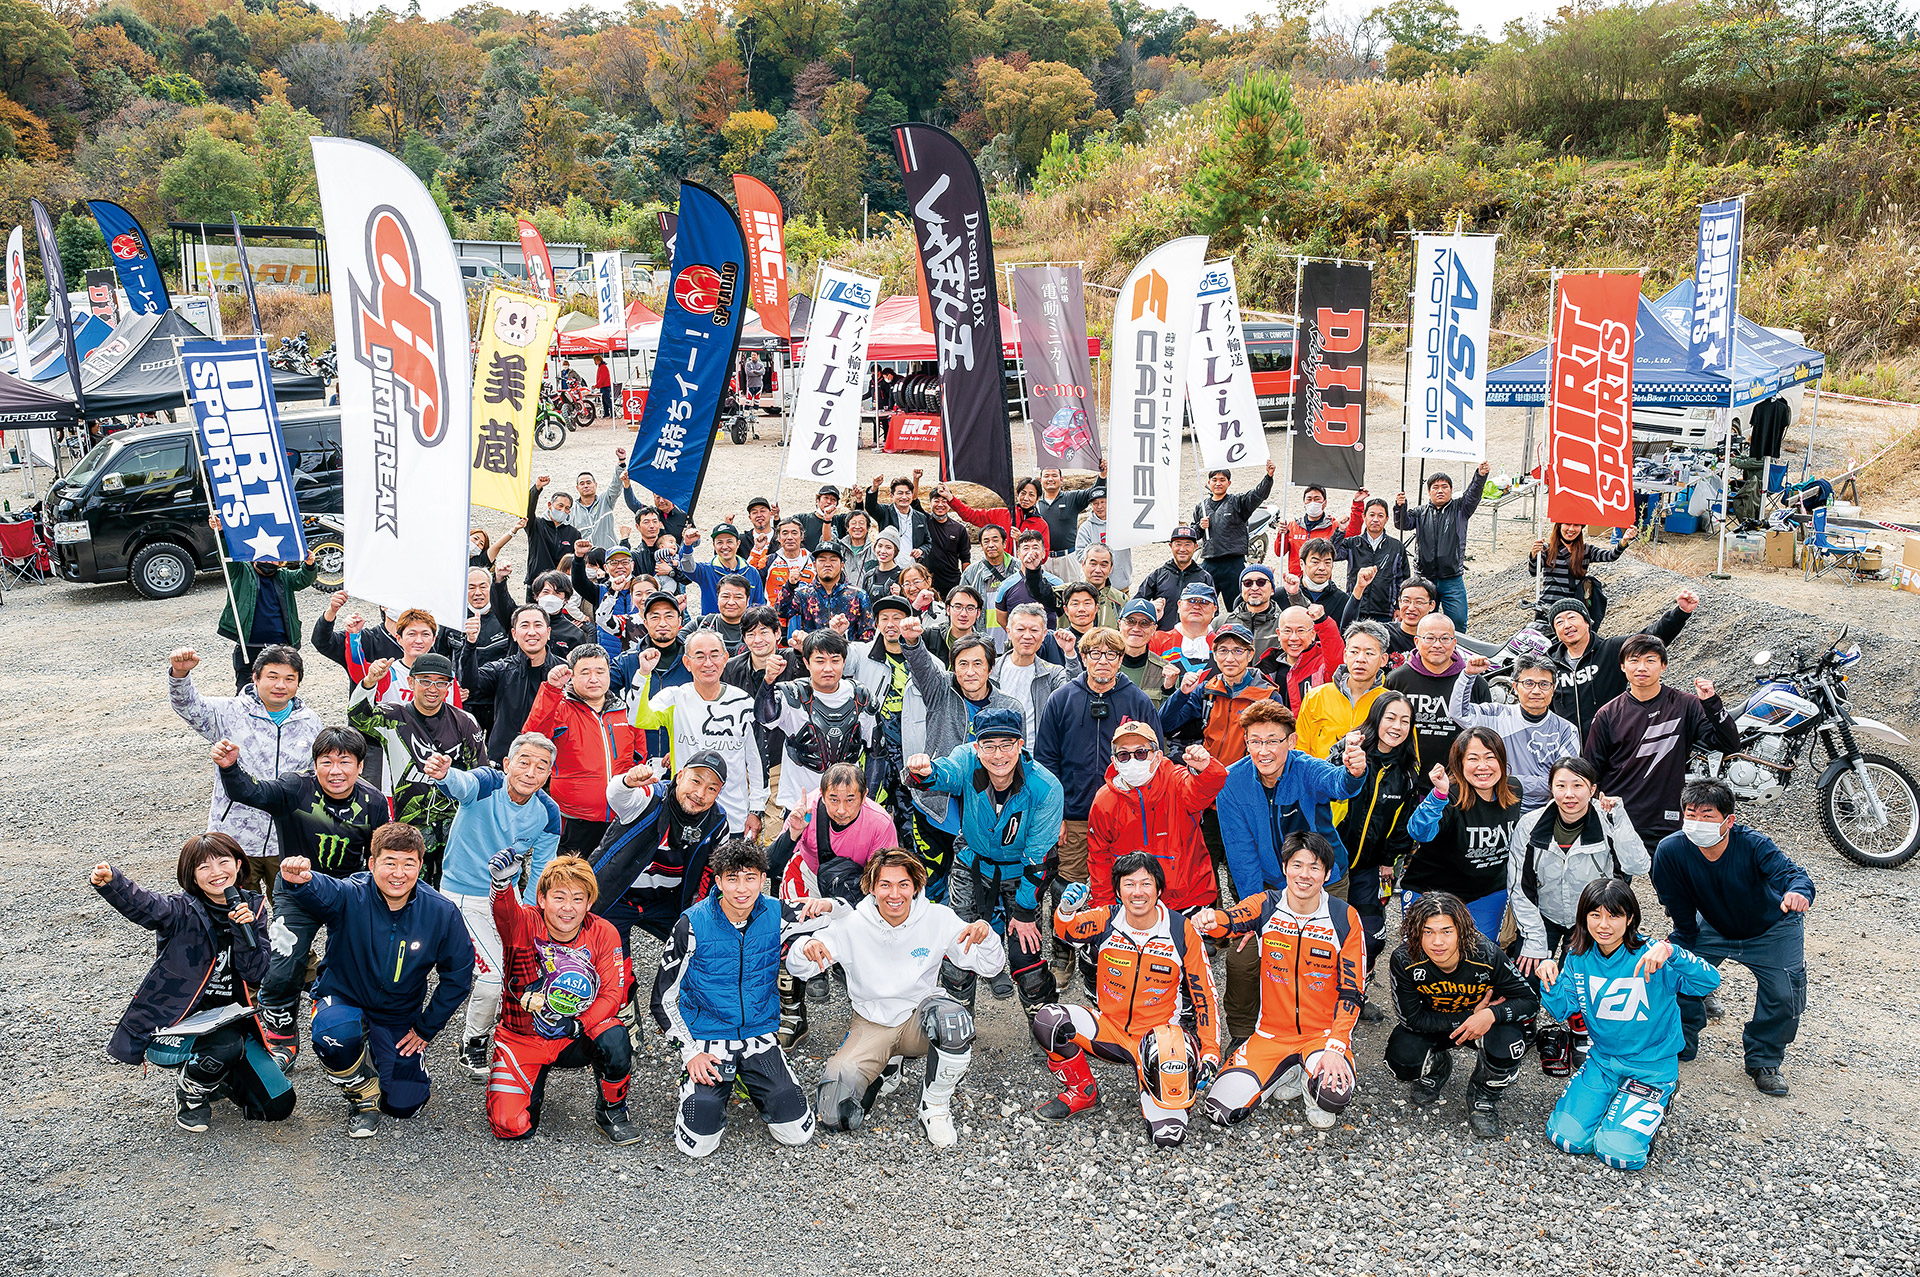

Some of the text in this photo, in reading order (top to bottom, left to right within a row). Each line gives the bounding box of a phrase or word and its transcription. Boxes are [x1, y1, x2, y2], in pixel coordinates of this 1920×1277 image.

[712, 262, 739, 328] SPTADAO
[748, 237, 757, 267] Rubber
[761, 277, 778, 307] TIRE
[963, 211, 987, 327] Dream Box
[1692, 219, 1716, 345] SPORTS
[1708, 217, 1737, 343] DIRT
[845, 313, 869, 386] バイク輸送
[1041, 283, 1062, 377] 電動ミニカー
[1220, 296, 1244, 367] バイク輸送
[1270, 331, 1291, 339] COMFORT
[1426, 248, 1447, 440] MOTOR OIL
[1446, 250, 1479, 441] A.S.H.
[190, 361, 250, 529] SPORTS
[216, 359, 291, 525] DIRT
[369, 342, 399, 538] DIRTFREAK
[473, 350, 528, 478] 美蔵
[1033, 383, 1087, 399] e-mo
[1133, 329, 1159, 530] CAOFEN
[1160, 331, 1177, 467] 電動オフロードバイク
[1554, 289, 1605, 515] DIRT
[1598, 319, 1631, 511] SPORTS
[1669, 393, 1718, 402] motocoto
[1148, 949, 1173, 957] TEAM
[1268, 925, 1333, 941] RACING TEAM
[1161, 1060, 1187, 1073] Arai
